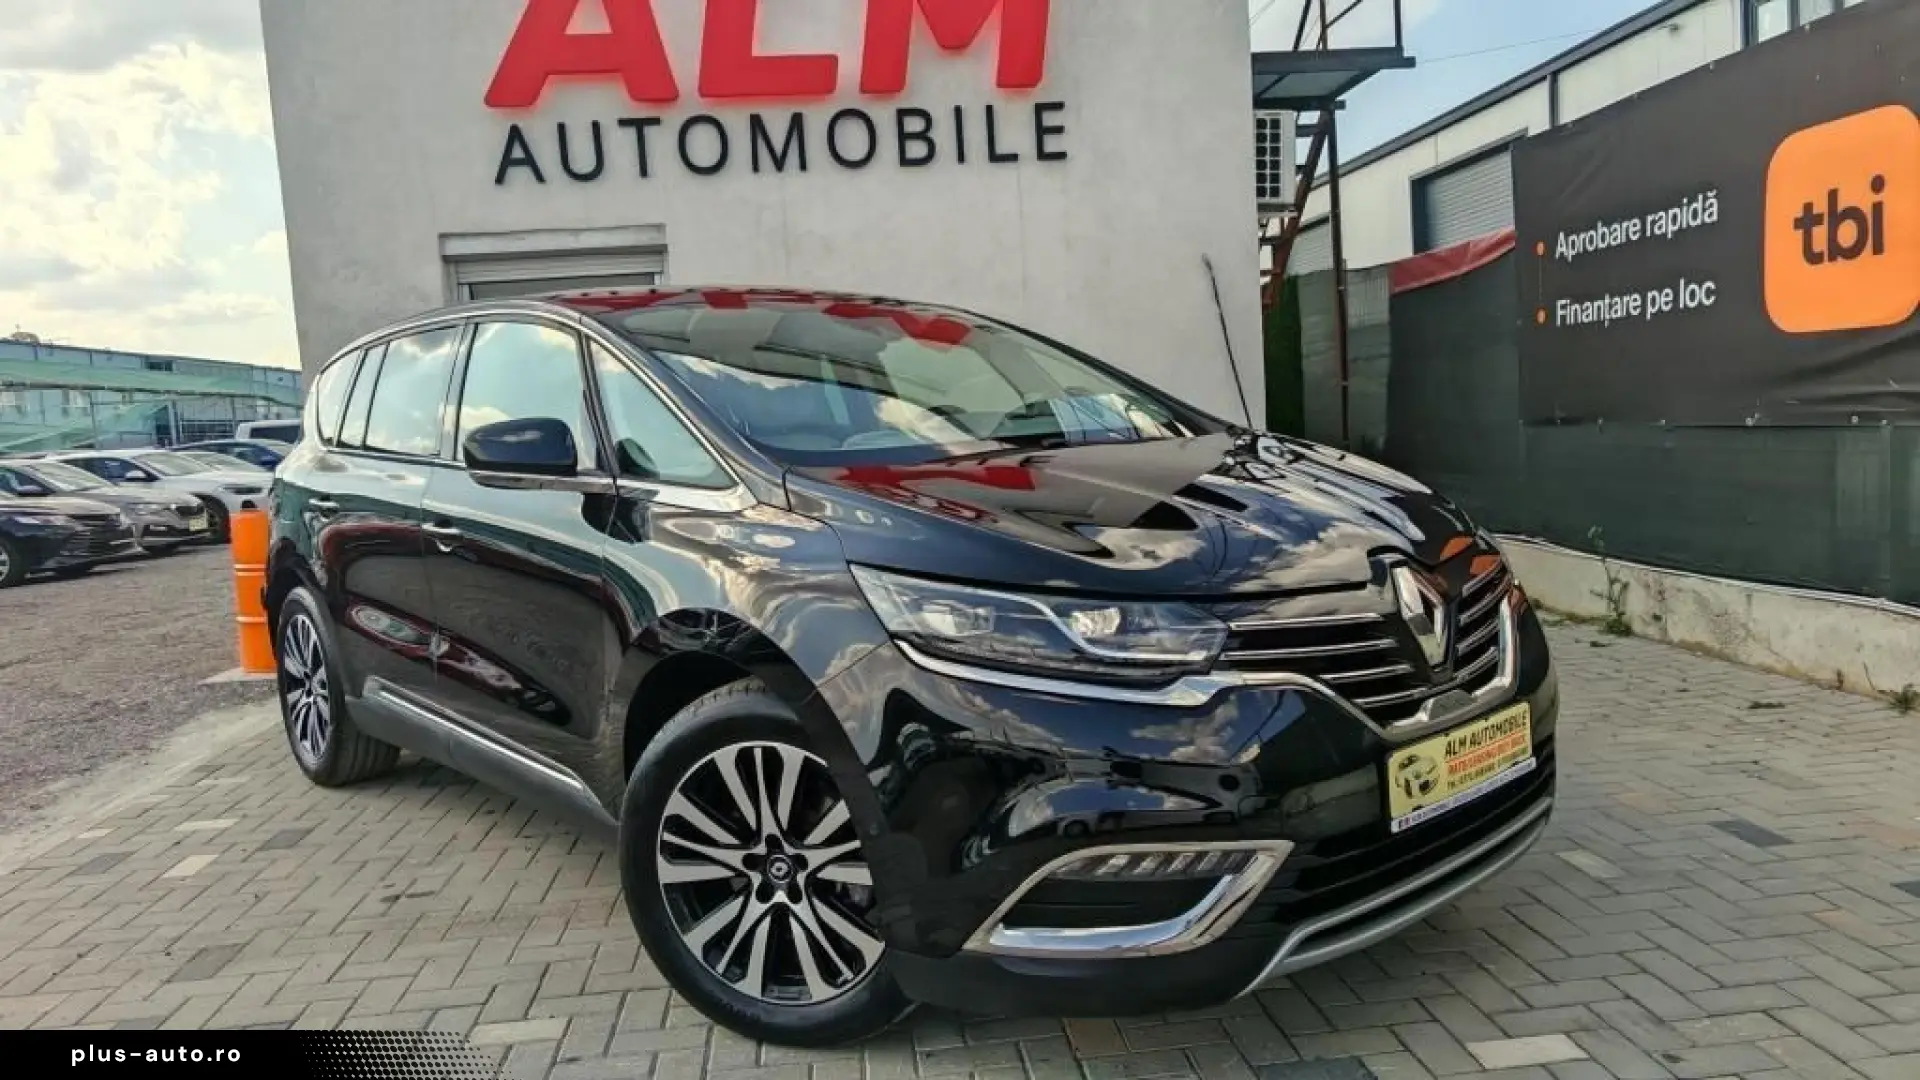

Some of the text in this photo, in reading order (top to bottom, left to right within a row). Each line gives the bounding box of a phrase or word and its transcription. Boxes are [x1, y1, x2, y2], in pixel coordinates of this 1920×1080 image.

[483, 0, 1050, 108] ALM
[494, 101, 1068, 185] AUTOMOBILE
[1555, 190, 1719, 262] Aprobare rapidă
[1793, 174, 1886, 266] tbi
[1555, 277, 1717, 328] Finanțare pe loc
[1445, 734, 1468, 757] ALM
[1469, 709, 1528, 746] AUTOMOBILE
